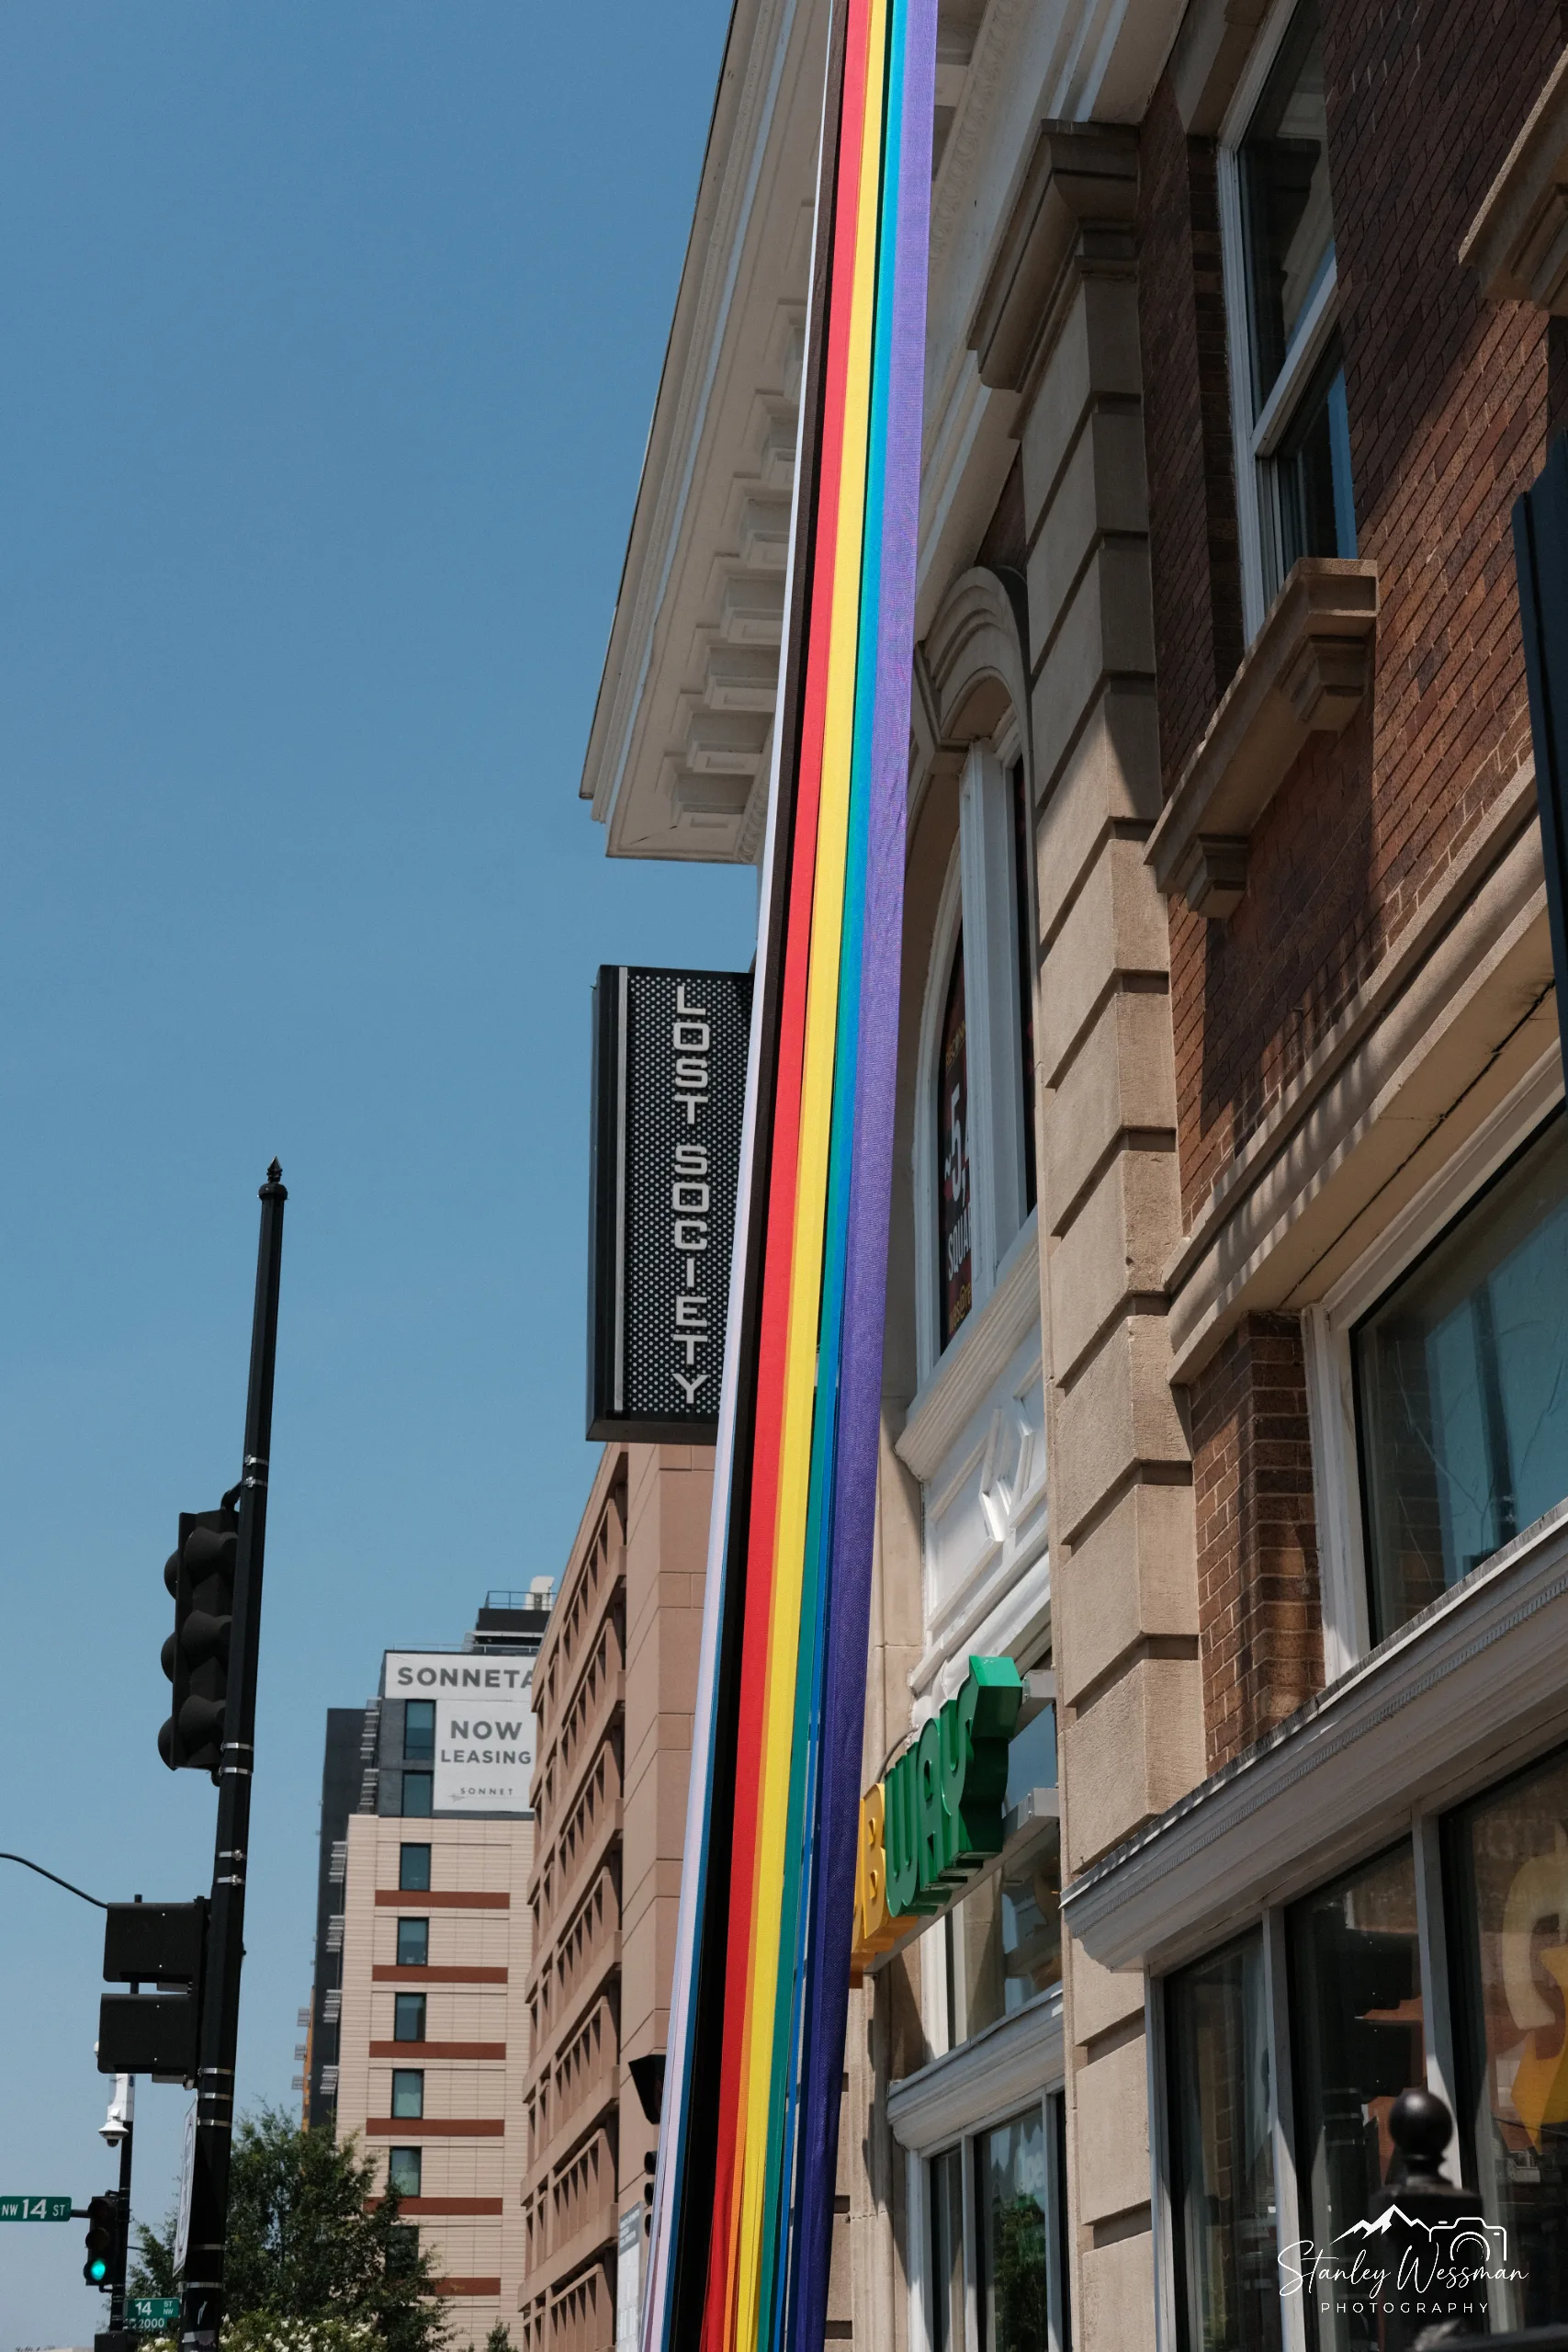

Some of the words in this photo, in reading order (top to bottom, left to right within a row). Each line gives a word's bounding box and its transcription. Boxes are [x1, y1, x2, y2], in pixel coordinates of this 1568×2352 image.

[672, 985, 710, 1125] LOST
[671, 1144, 710, 1405] SOCIETY
[450, 1720, 523, 1740] NOW
[441, 1749, 531, 1765] LEASING
[460, 1787, 513, 1795] SONNET
[1, 2203, 18, 2216] NW
[22, 2199, 47, 2219] 14
[52, 2204, 65, 2217] ST
[135, 2301, 152, 2315] 14
